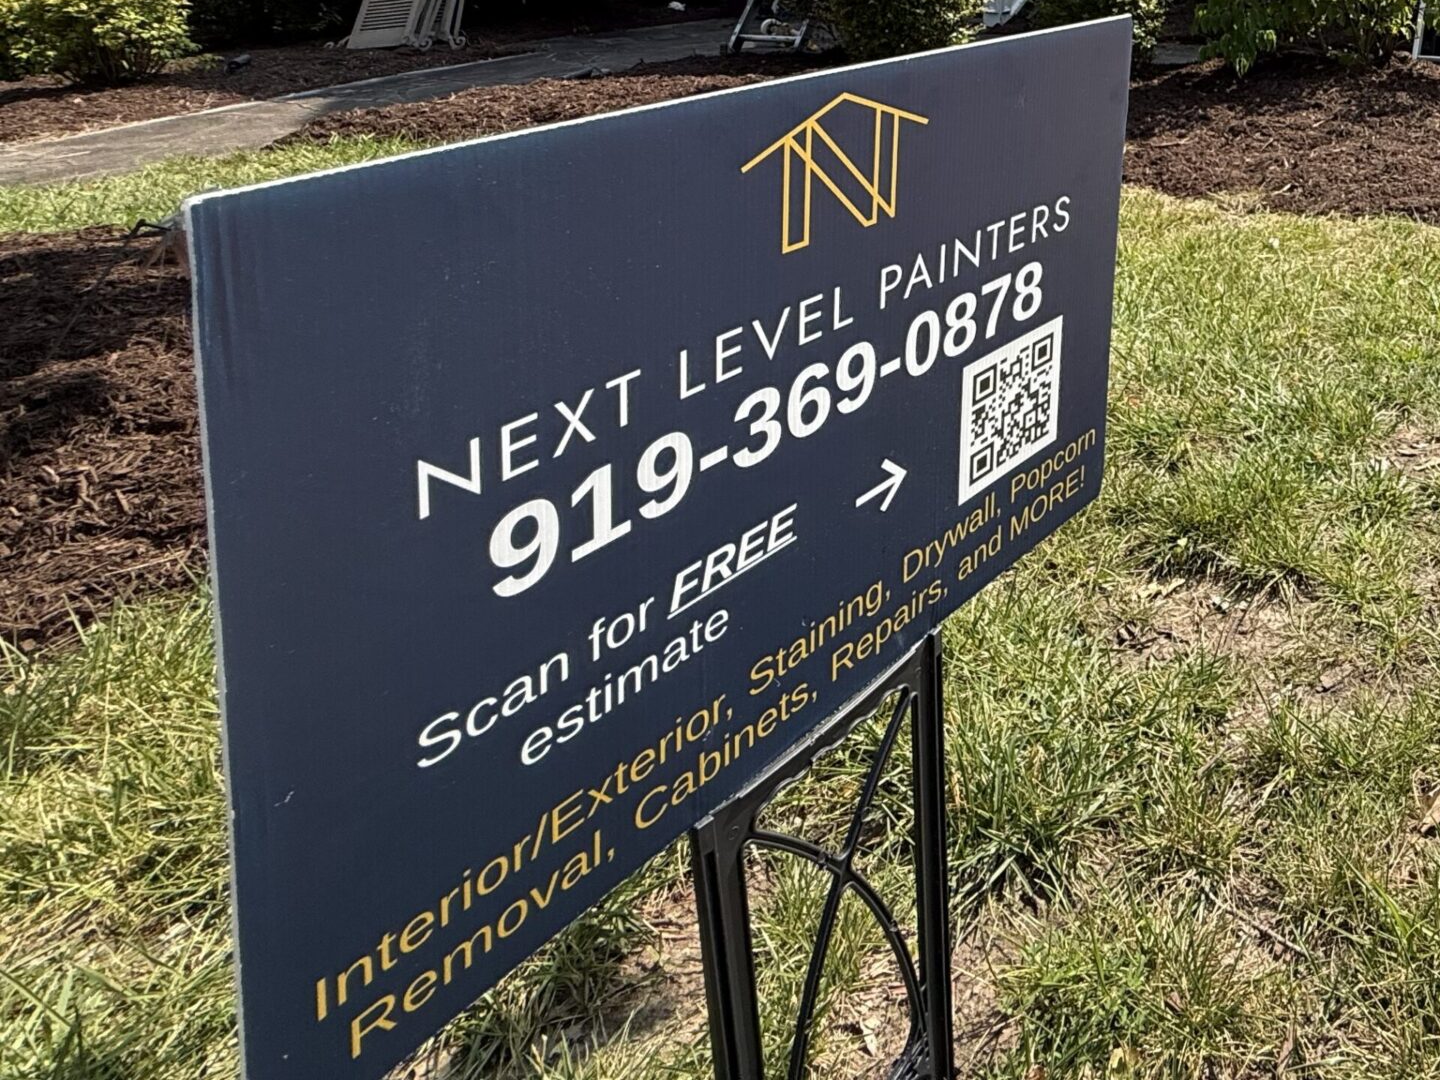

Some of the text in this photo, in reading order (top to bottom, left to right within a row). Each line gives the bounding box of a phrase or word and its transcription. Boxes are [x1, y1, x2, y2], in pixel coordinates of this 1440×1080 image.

[416, 196, 1071, 520] NEXT LEVEL PAINTERS
[488, 261, 1043, 598] 919-369-0878
[316, 428, 1096, 1022] Interior/Exterior, Staining, Drywall, Popcorn
[351, 465, 1085, 1060] Removal, Cabinets, Repairs, and MORE!
[416, 503, 798, 768] Scan for FREE
[520, 609, 729, 766] estimate
